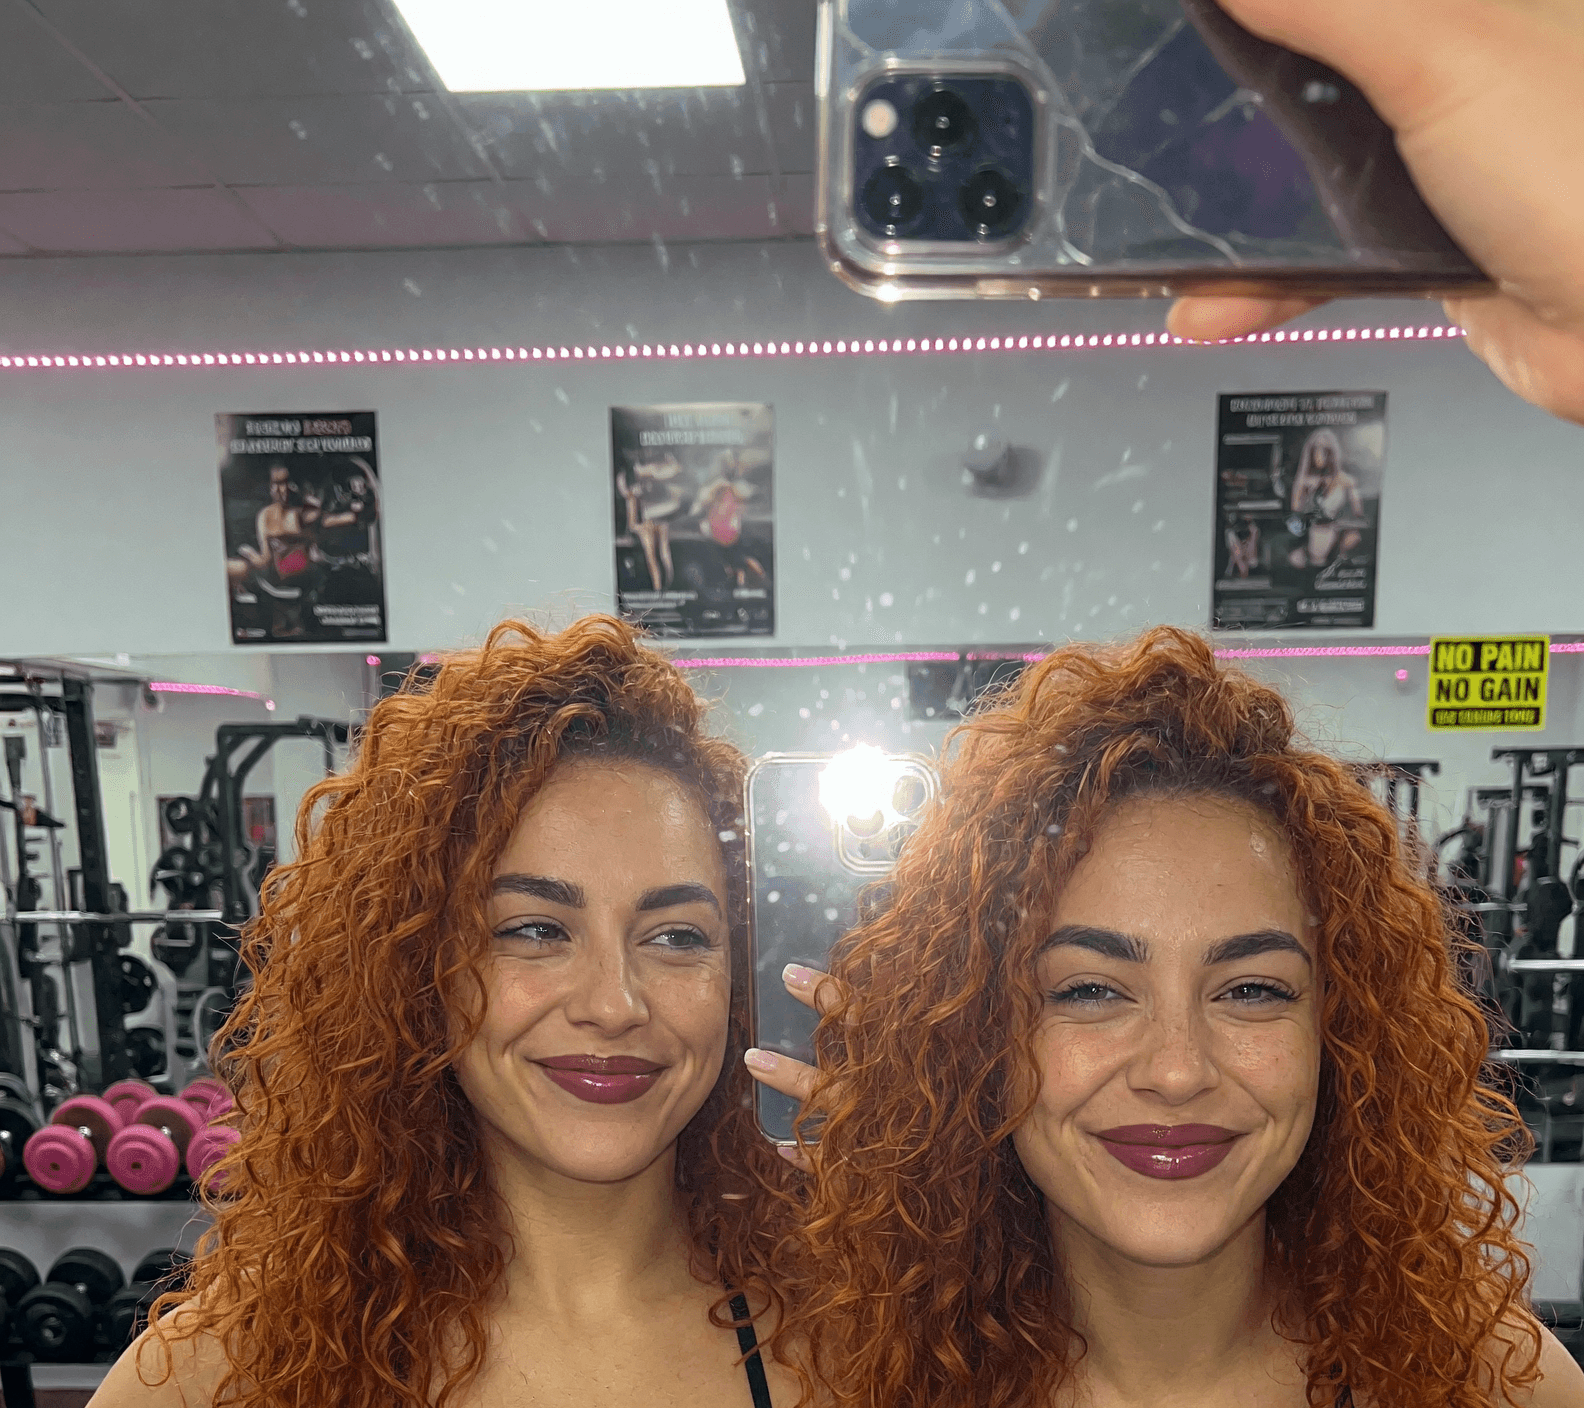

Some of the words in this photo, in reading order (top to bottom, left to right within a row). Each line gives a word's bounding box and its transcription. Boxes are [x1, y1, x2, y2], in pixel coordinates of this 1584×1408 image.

[1437, 644, 1473, 670] NO
[1480, 643, 1540, 670] PAIN
[1436, 677, 1469, 702] NO
[1481, 676, 1540, 702] GAIN
